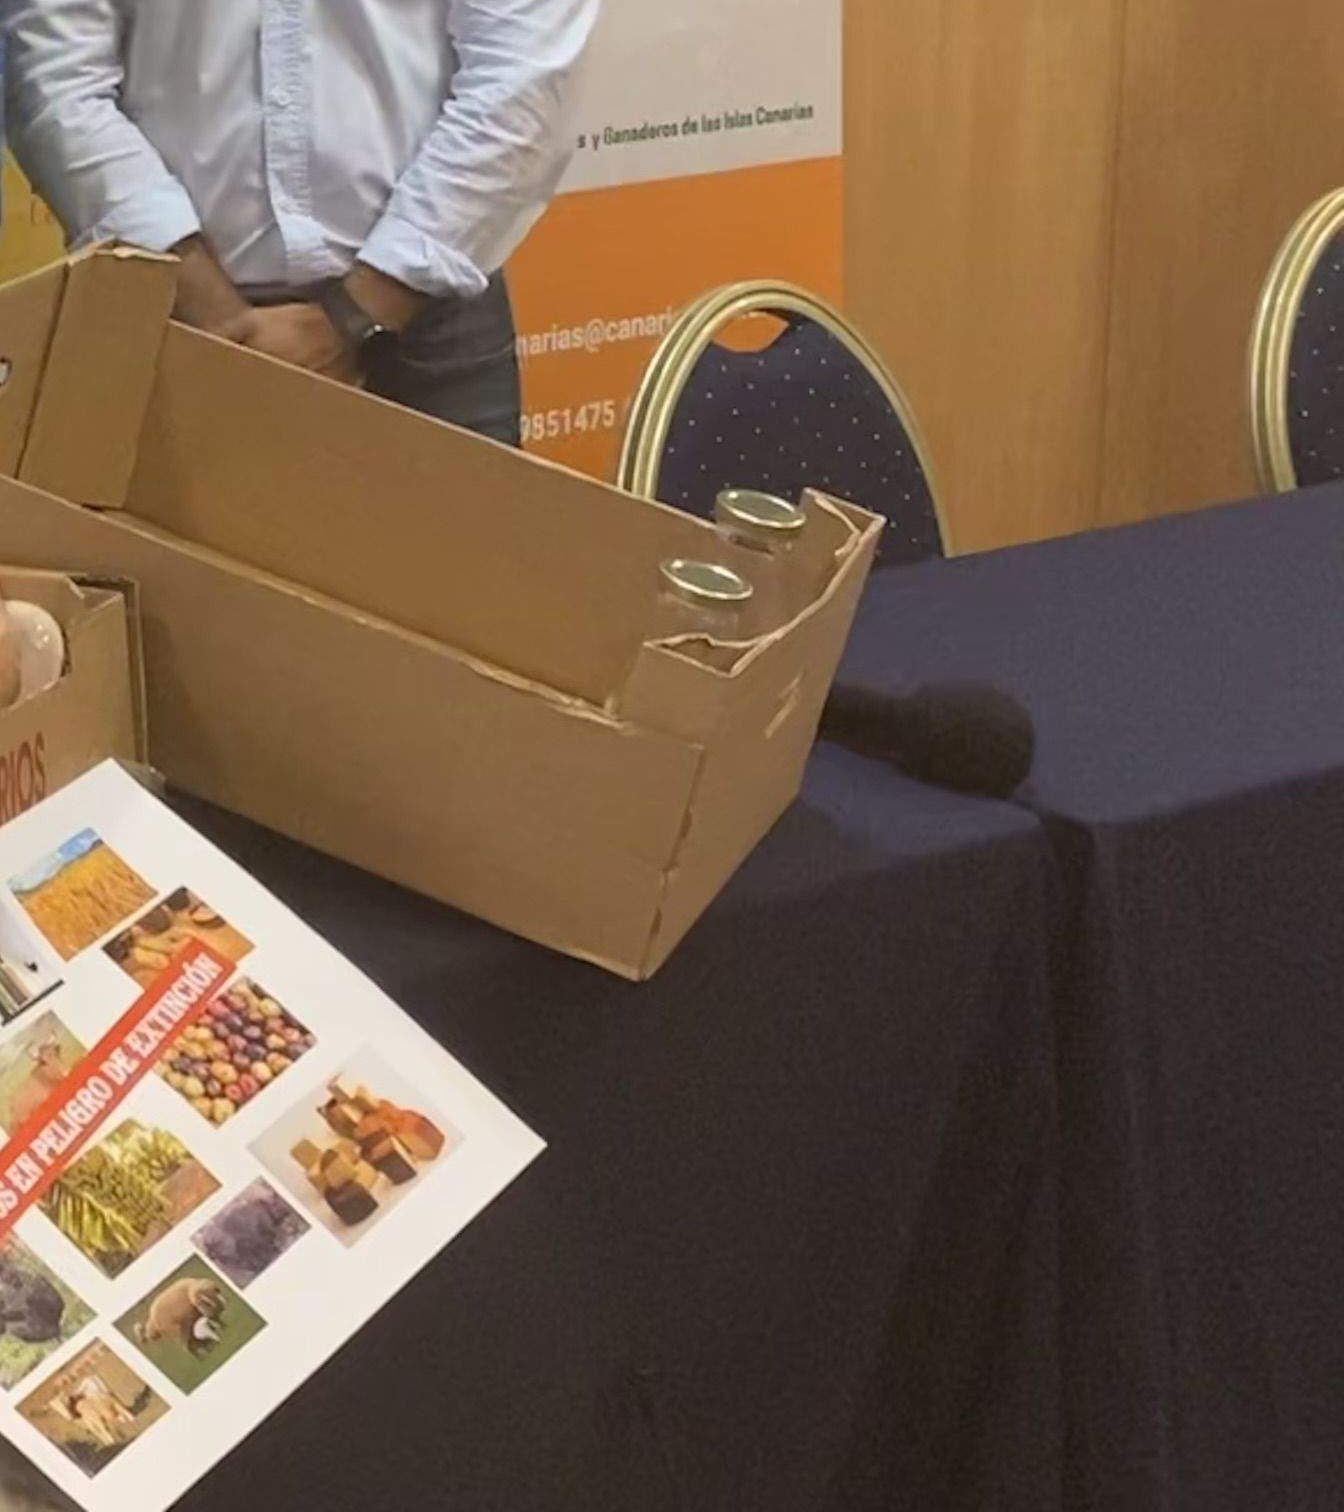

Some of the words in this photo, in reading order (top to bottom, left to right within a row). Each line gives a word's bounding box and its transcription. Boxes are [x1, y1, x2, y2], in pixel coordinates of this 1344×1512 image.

[603, 118, 678, 147] Ganaderos
[681, 115, 698, 136] de
[701, 112, 721, 133] las
[724, 109, 753, 130] Islas
[755, 101, 814, 126] Canarias
[6, 1149, 42, 1188] EN
[29, 1074, 114, 1176] PELIGRO
[100, 1043, 137, 1086] DE
[123, 951, 224, 1062] EXTINCIÓN
